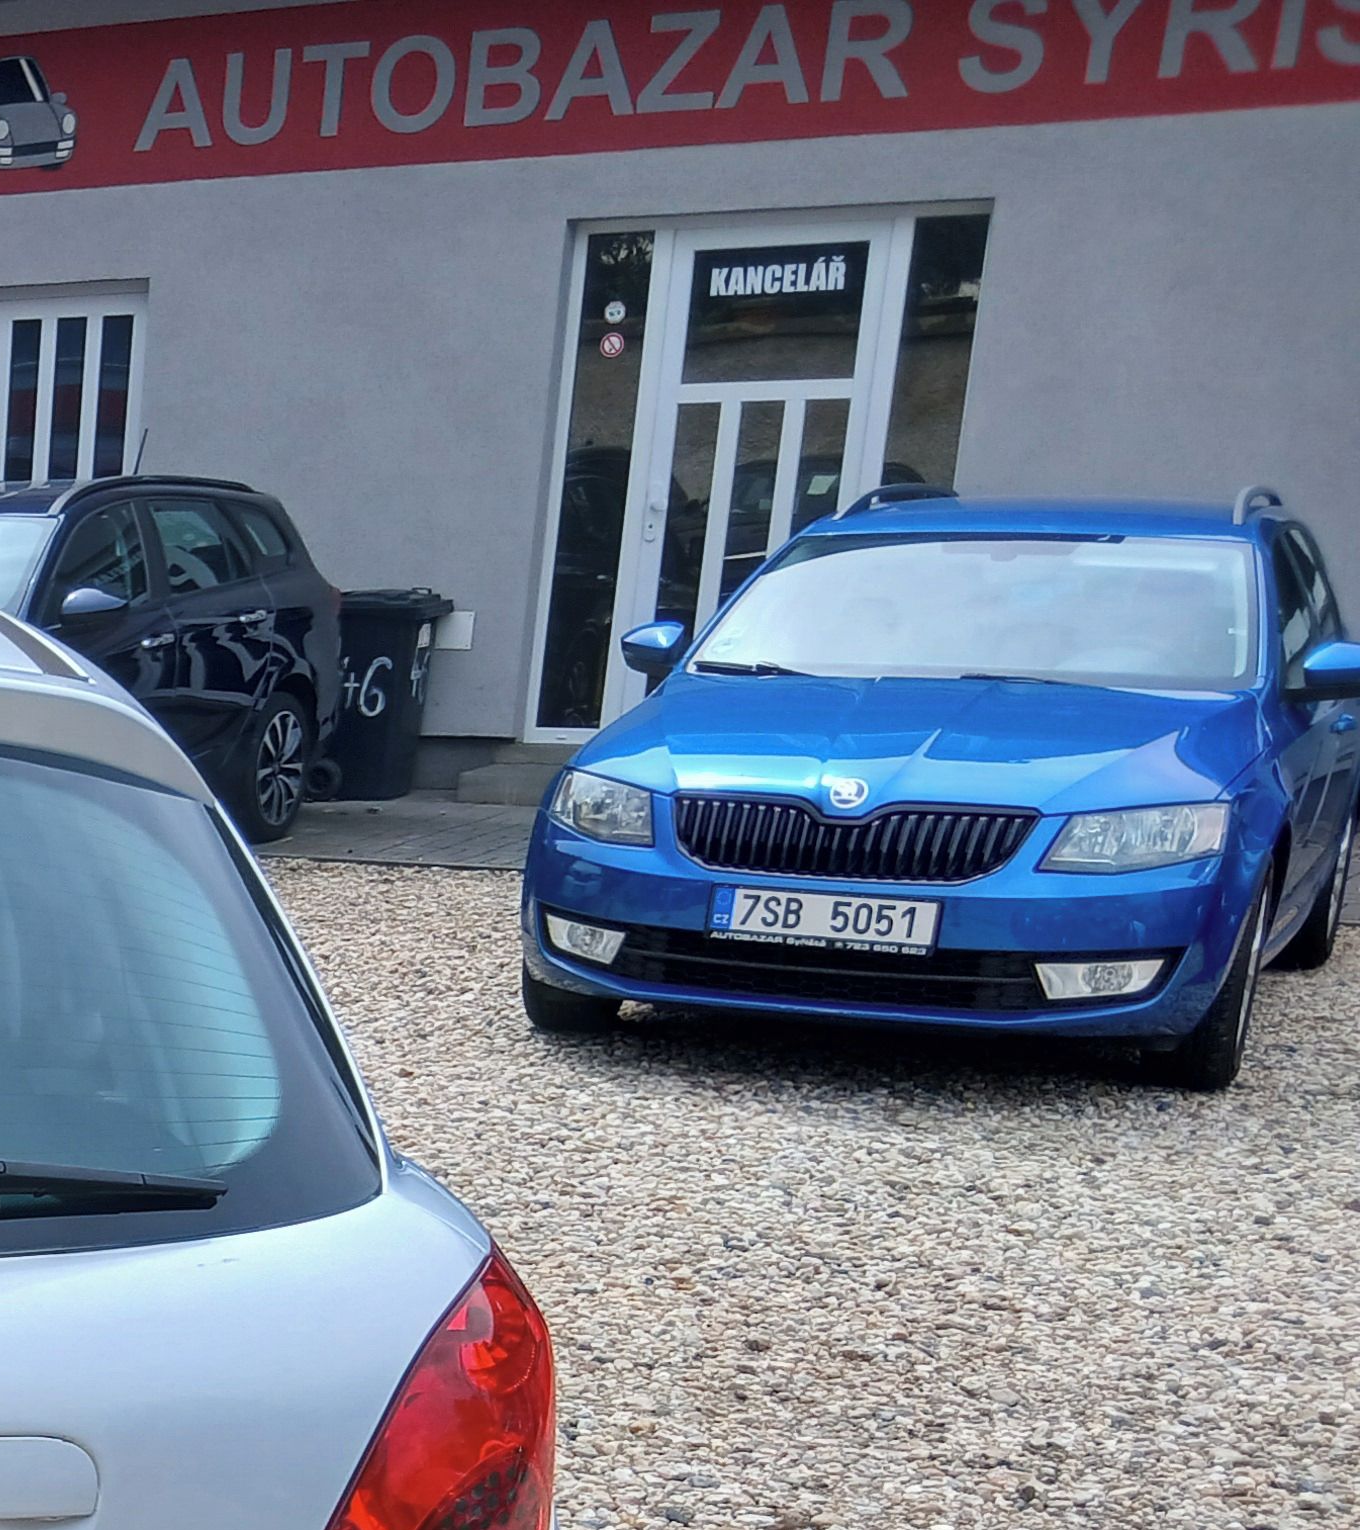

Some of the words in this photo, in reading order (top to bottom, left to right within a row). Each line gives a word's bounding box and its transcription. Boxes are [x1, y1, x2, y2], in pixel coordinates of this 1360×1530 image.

[132, 0, 914, 153] AUTOBAZAR
[709, 255, 847, 297] KANCELÁŘ
[710, 931, 783, 943] AUTOBAZAR
[713, 913, 730, 925] CZ
[738, 893, 804, 929] 7SB
[829, 899, 918, 939] 5051
